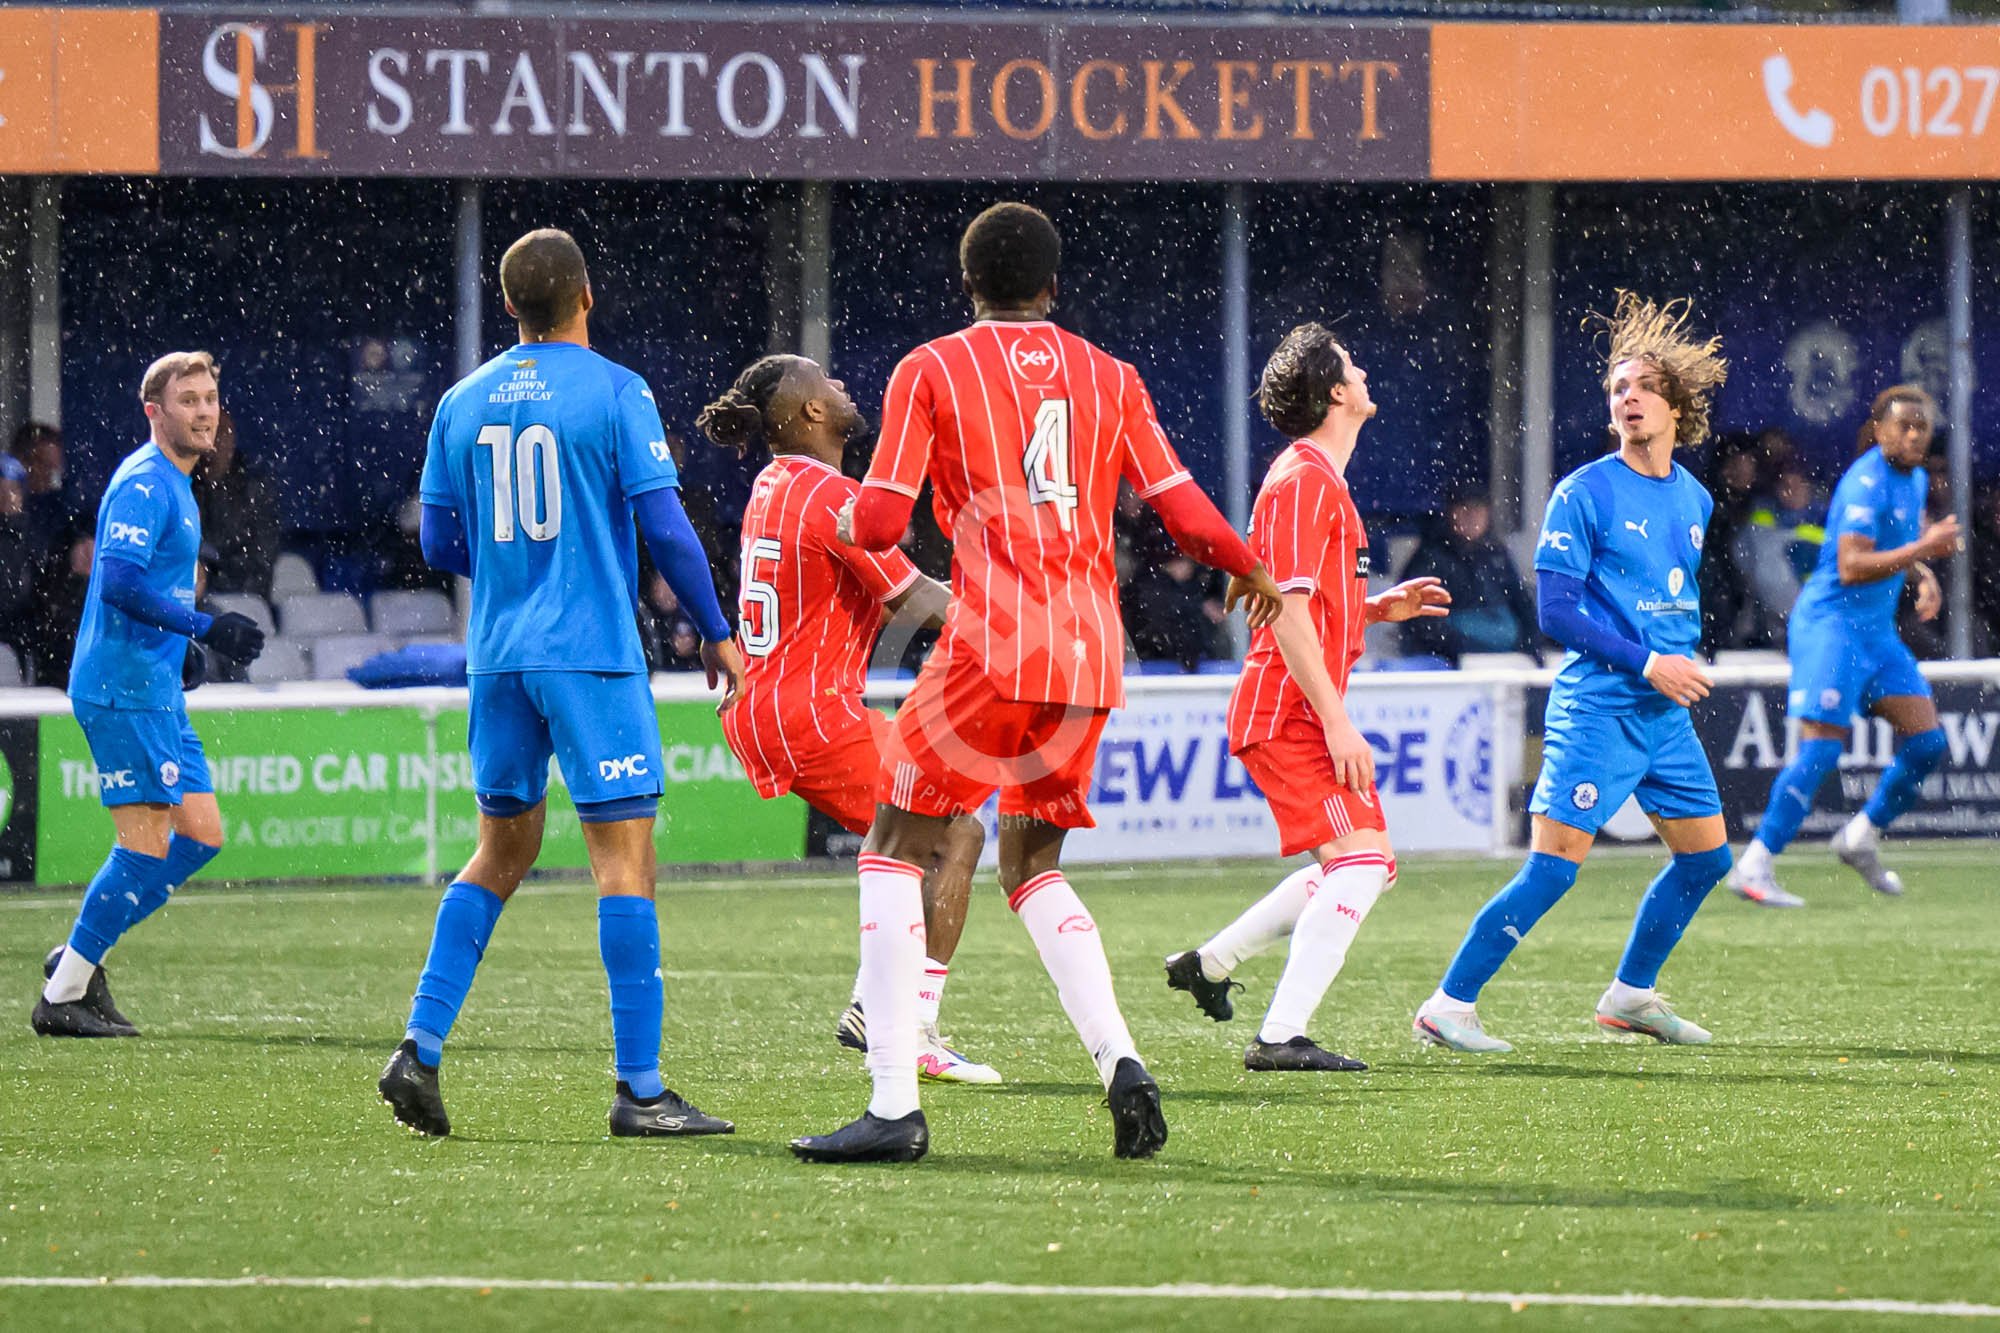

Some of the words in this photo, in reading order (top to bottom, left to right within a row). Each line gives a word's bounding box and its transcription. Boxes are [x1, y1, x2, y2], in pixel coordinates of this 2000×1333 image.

[366, 48, 868, 139] STANTON
[913, 57, 1400, 141] HOCKETT
[1861, 66, 2000, 138] 0127
[499, 381, 547, 392] CROWN
[512, 369, 538, 381] THE
[488, 391, 554, 403] BILLERICAY
[1021, 398, 1079, 533] 4
[476, 423, 562, 543] 10
[109, 521, 149, 547] DMC
[1538, 530, 1572, 551] MC
[60, 759, 100, 799] TH
[206, 753, 303, 795] DIFIED
[312, 752, 389, 793] CAR
[599, 754, 649, 781] DMC
[1086, 737, 1200, 804] EW
[260, 816, 348, 848] QUOTE
